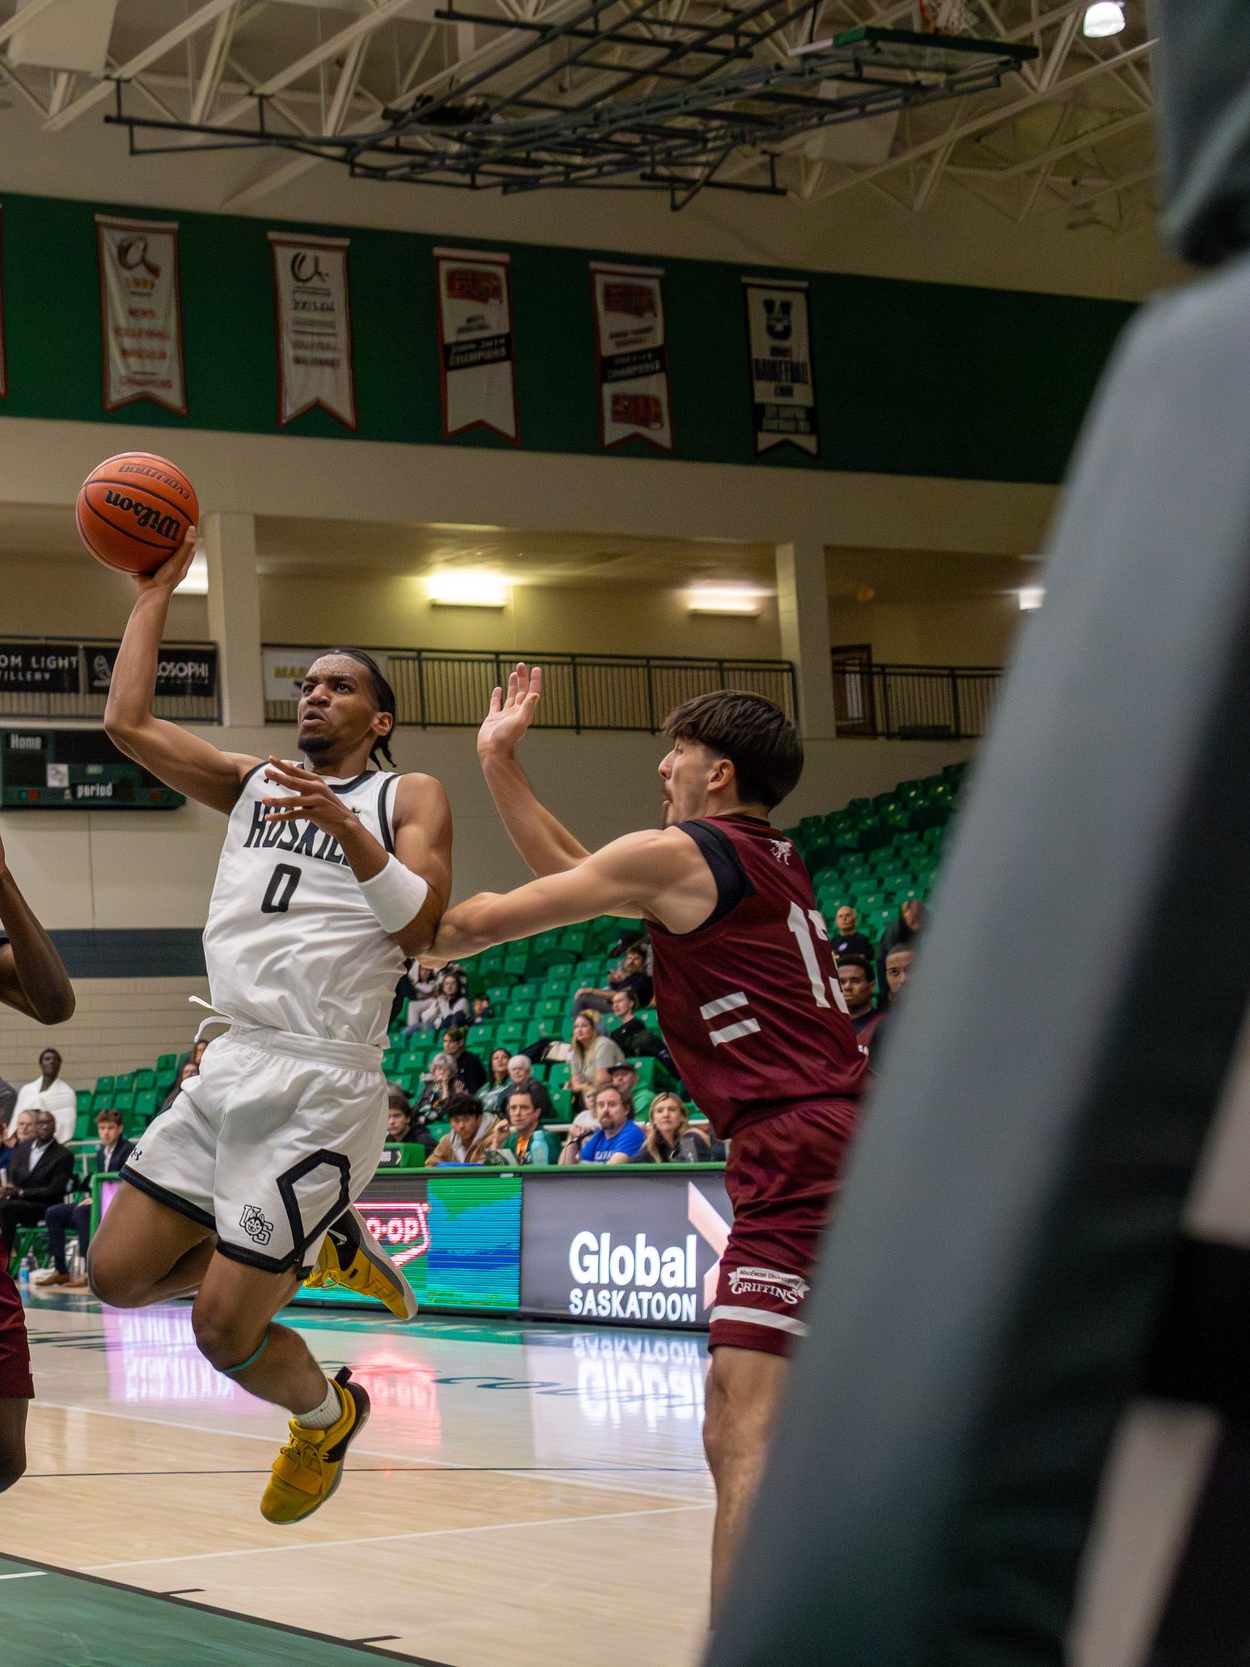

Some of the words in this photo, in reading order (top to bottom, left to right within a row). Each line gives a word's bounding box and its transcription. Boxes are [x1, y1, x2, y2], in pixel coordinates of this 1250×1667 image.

[104, 489, 181, 541] Wilson
[31, 655, 78, 670] LIGHT
[157, 661, 209, 677] OSOPHI
[10, 733, 42, 750] Home
[76, 782, 113, 798] period
[261, 863, 302, 914] 0
[569, 1230, 697, 1288] Global
[569, 1288, 697, 1322] SASKATOON
[731, 1281, 798, 1305] GRIFFINS
